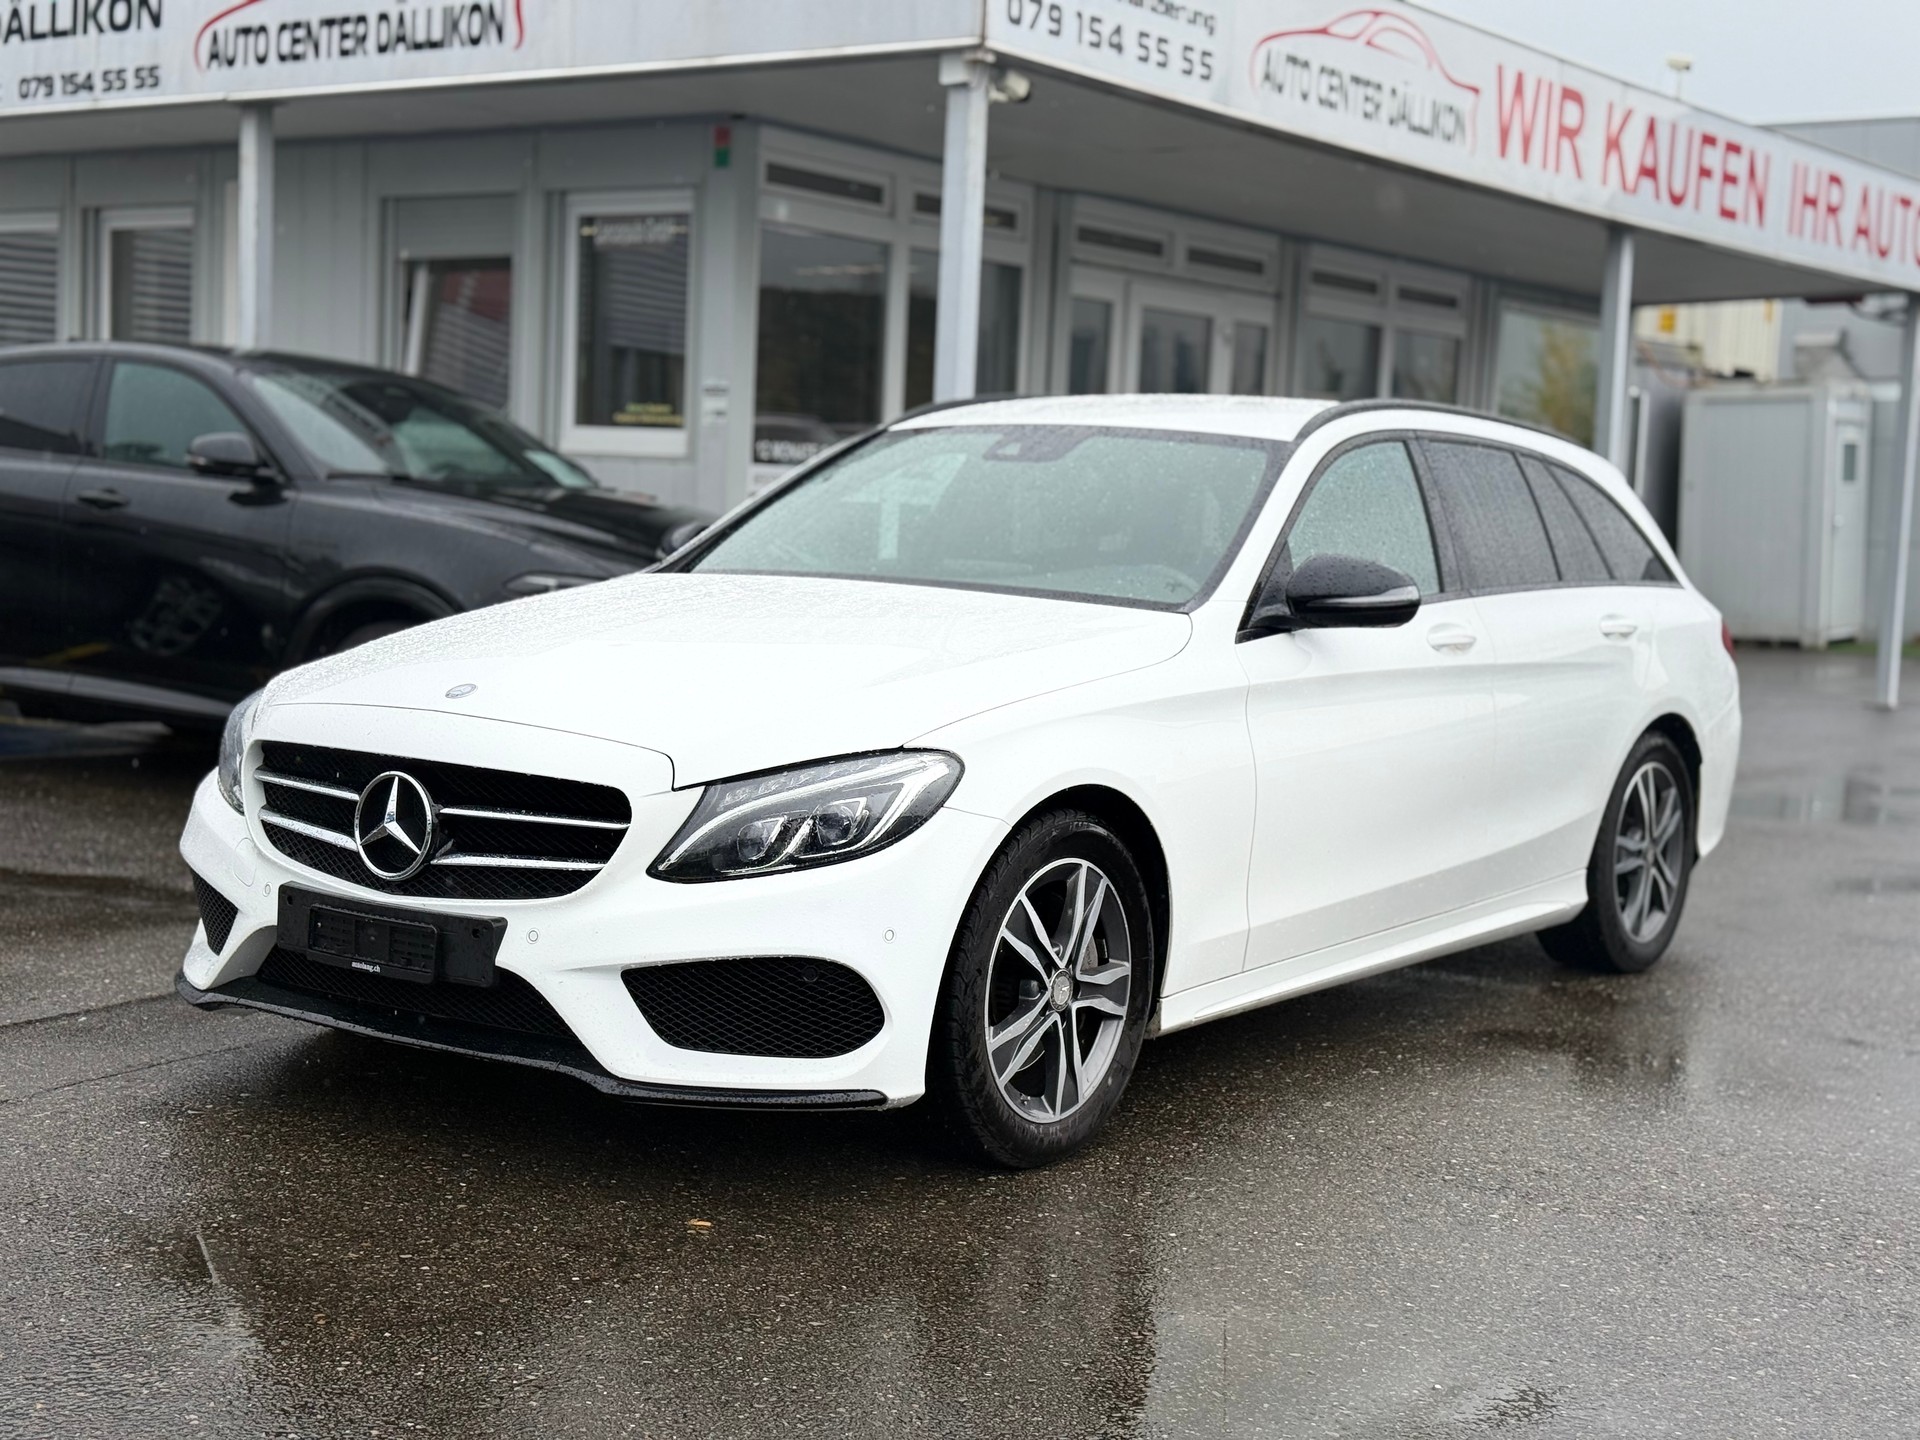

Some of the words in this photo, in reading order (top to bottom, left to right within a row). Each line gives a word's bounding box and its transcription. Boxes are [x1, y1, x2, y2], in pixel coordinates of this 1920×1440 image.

[0, 0, 162, 43] ÄLLIKON
[207, 25, 270, 69] AUTO
[277, 14, 368, 62] CENTER
[1008, 0, 1062, 37] 079
[1076, 11, 1124, 55] 154
[1137, 31, 1169, 68] 55
[1181, 44, 1213, 81] 55
[19, 76, 53, 99] 079
[61, 72, 94, 95] 154
[102, 69, 127, 92] 55
[134, 66, 160, 89] 55
[1260, 48, 1311, 103] AUTO
[1317, 63, 1383, 122] CENTER
[1388, 80, 1467, 144] DÄLLIKON
[1497, 63, 1584, 181] WIR
[1601, 100, 1771, 229] KAUFEN
[1788, 162, 1844, 248] IHR
